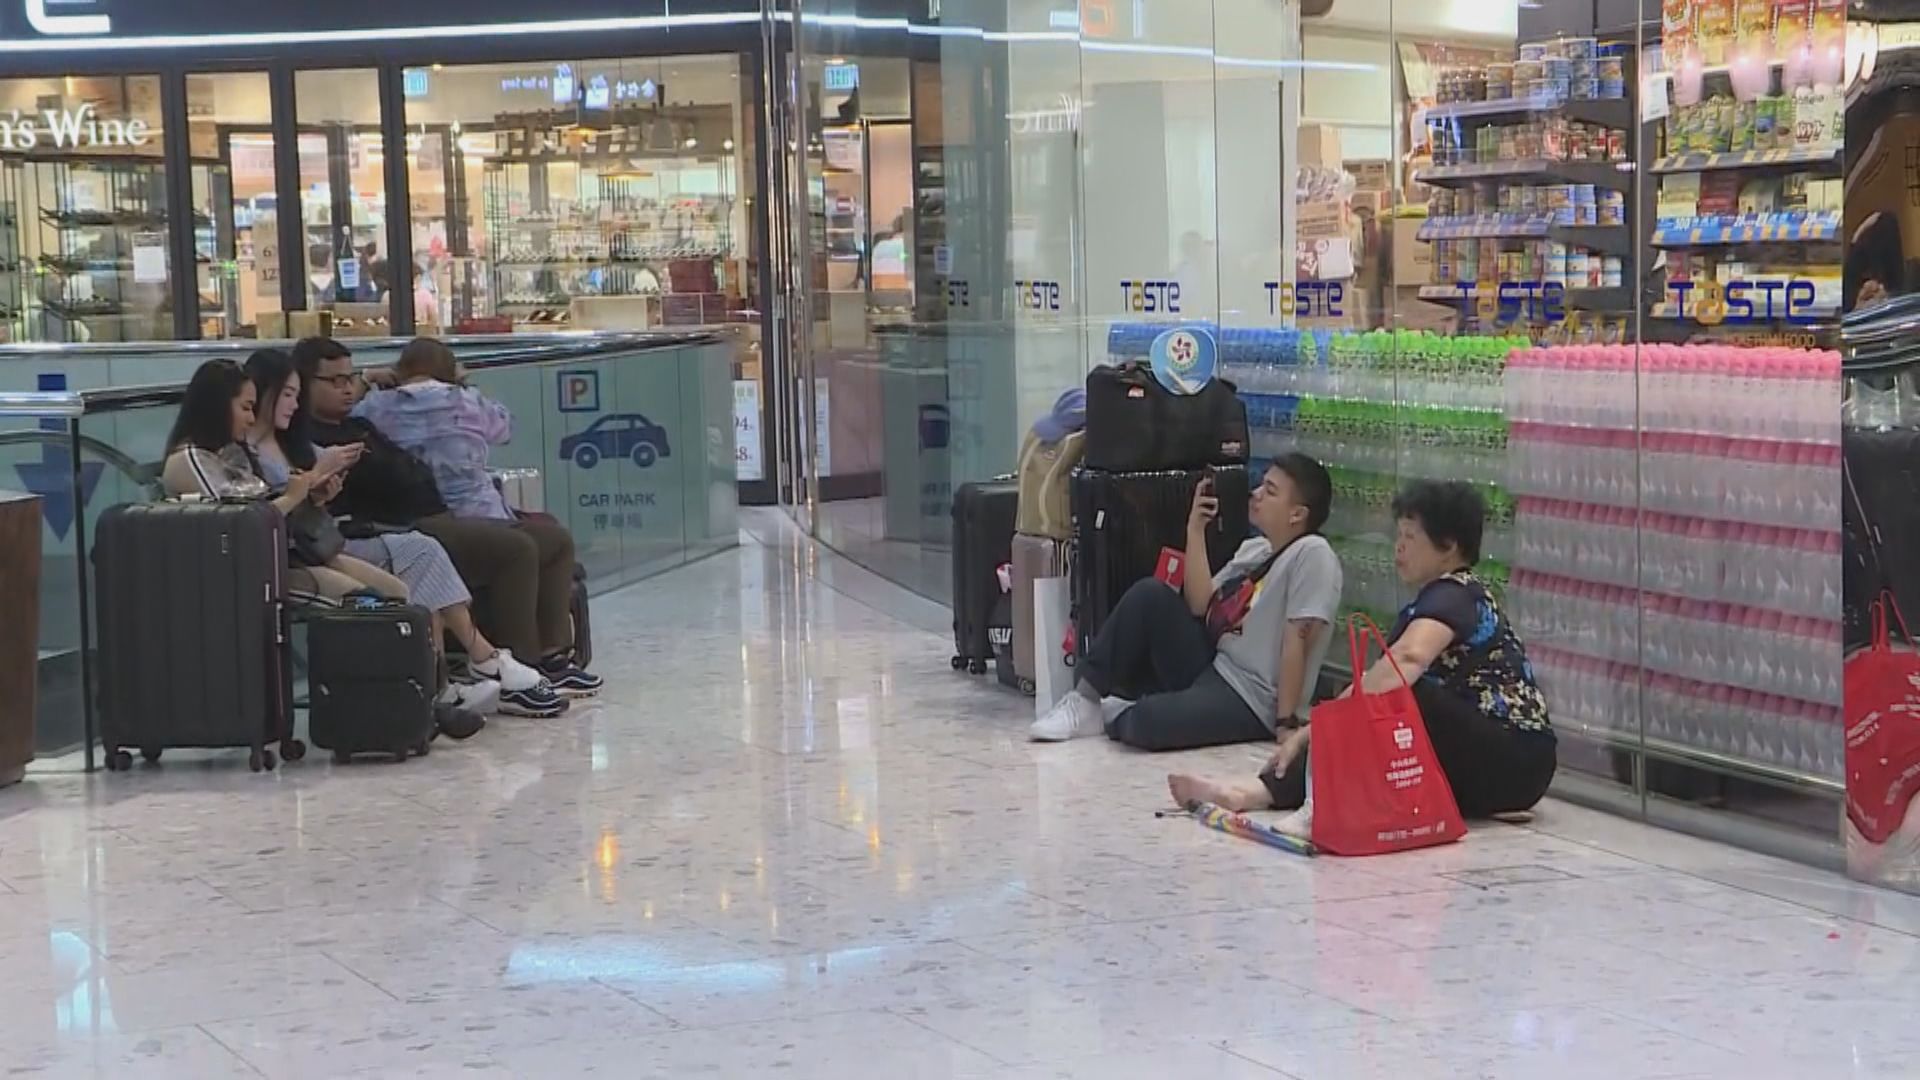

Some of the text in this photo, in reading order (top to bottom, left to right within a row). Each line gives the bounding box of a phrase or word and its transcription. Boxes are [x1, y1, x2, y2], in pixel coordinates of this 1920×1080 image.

[44, 103, 148, 147] Wine
[570, 378, 588, 405] P
[578, 493, 656, 507] CAR PARK
